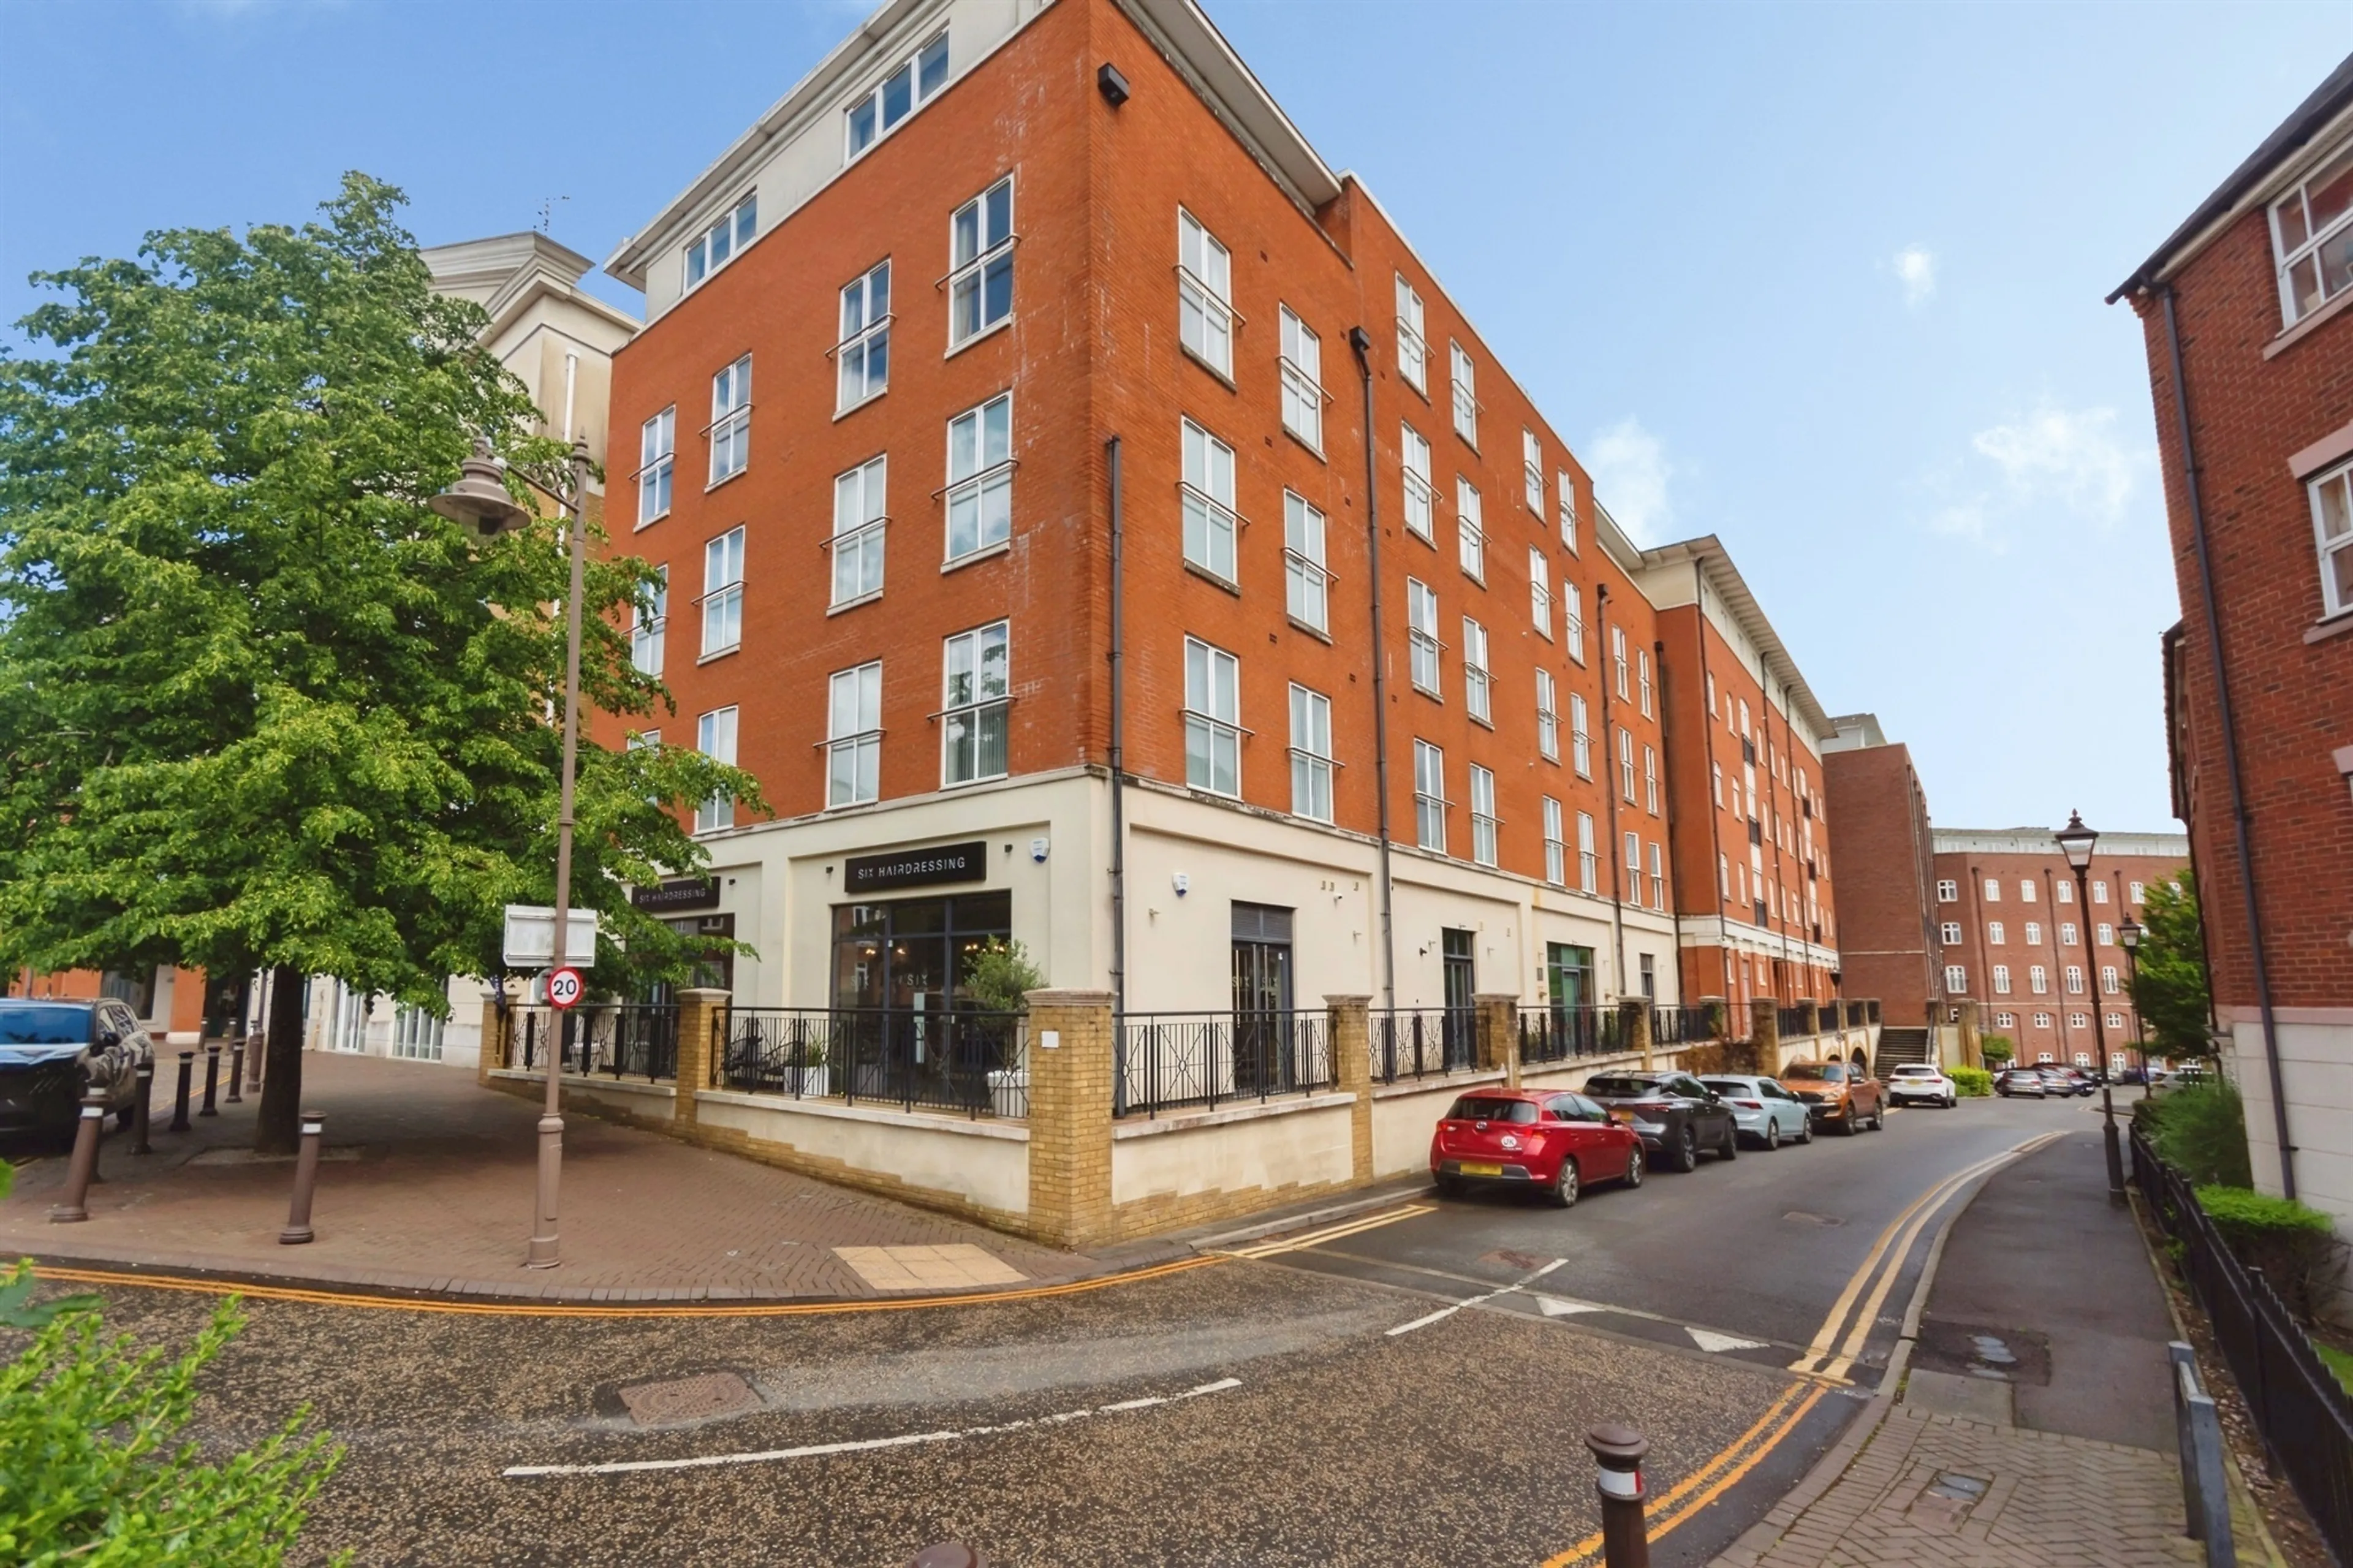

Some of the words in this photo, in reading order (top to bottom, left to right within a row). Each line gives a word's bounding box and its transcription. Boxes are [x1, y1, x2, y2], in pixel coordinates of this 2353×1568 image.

[858, 868, 874, 880] SIX
[879, 857, 965, 877] HAIRDRESSING
[553, 979, 577, 996] 20
[907, 974, 928, 986] SIX
